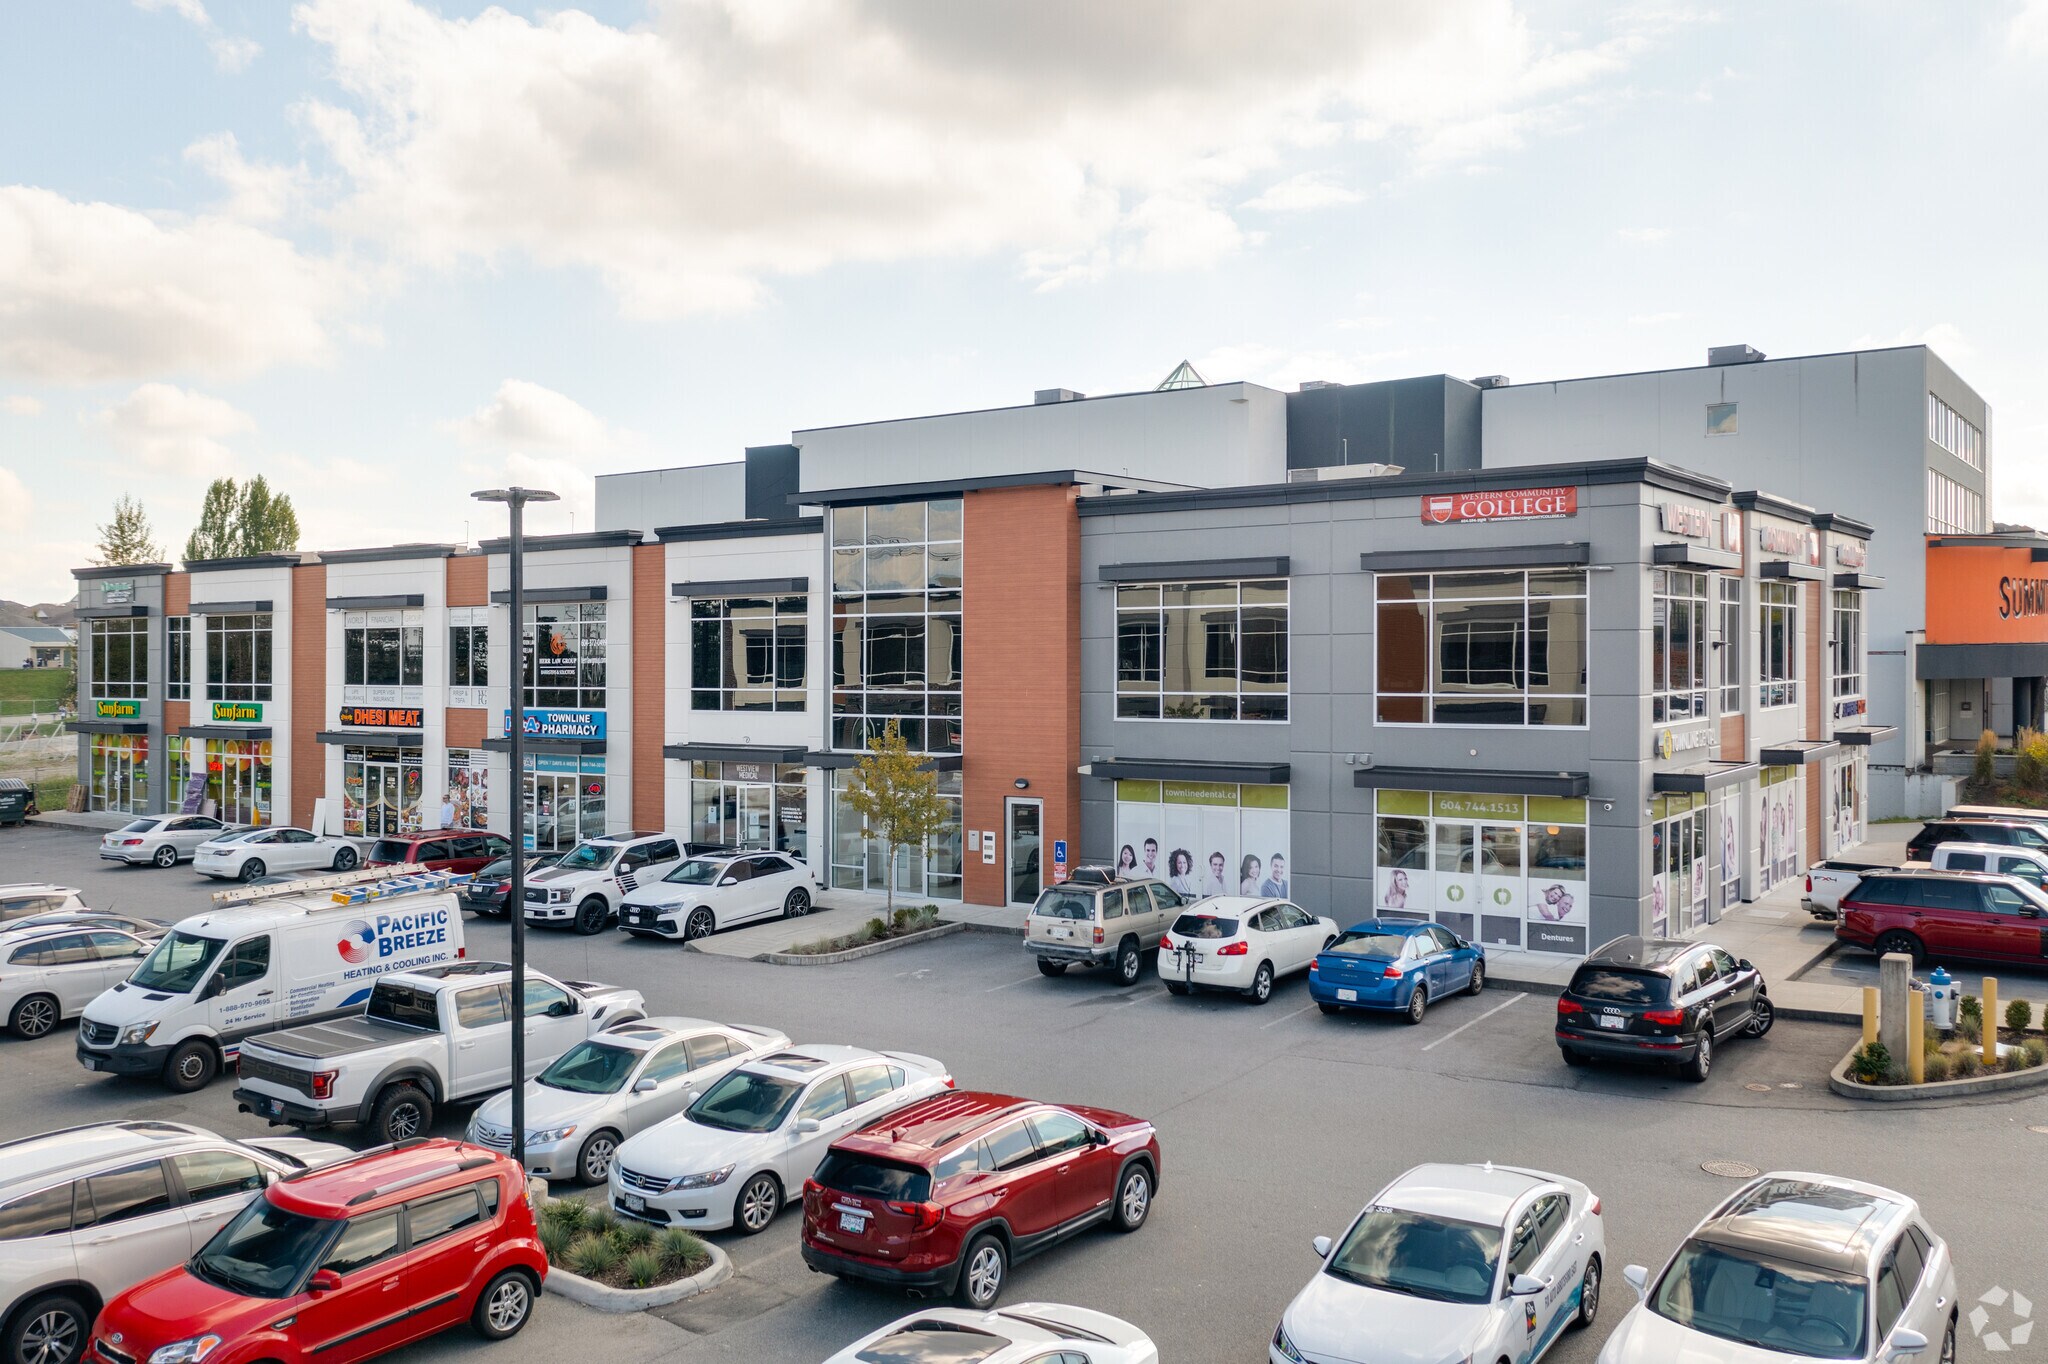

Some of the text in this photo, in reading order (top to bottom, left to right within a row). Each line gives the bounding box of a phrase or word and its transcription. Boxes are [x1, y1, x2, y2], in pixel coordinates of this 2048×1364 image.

[1461, 488, 1566, 500] WESTERN COMMUNITY
[1460, 496, 1567, 518] COLLEGE
[97, 700, 134, 718] Sunfarm
[214, 703, 256, 721] Sunfarm
[353, 709, 387, 725] DHESI
[388, 709, 420, 726] MEAT
[547, 713, 591, 723] TOWNLINE
[541, 724, 598, 735] PHARMACY
[736, 764, 760, 773] WESTVIEW
[738, 771, 759, 780] MEDICAL
[1165, 788, 1237, 799] townlinedental.ca
[1440, 799, 1519, 814] 604.744.1513
[376, 909, 448, 936] PACIFIC
[378, 928, 447, 958] BREEZE
[1541, 932, 1575, 943] Dentures
[343, 952, 449, 980] HEATING & COOLING INC.
[290, 984, 318, 994] Commercial
[219, 998, 271, 1013] 1-888-970-9695
[243, 1012, 266, 1021] Service
[841, 1195, 862, 1208] GMC
